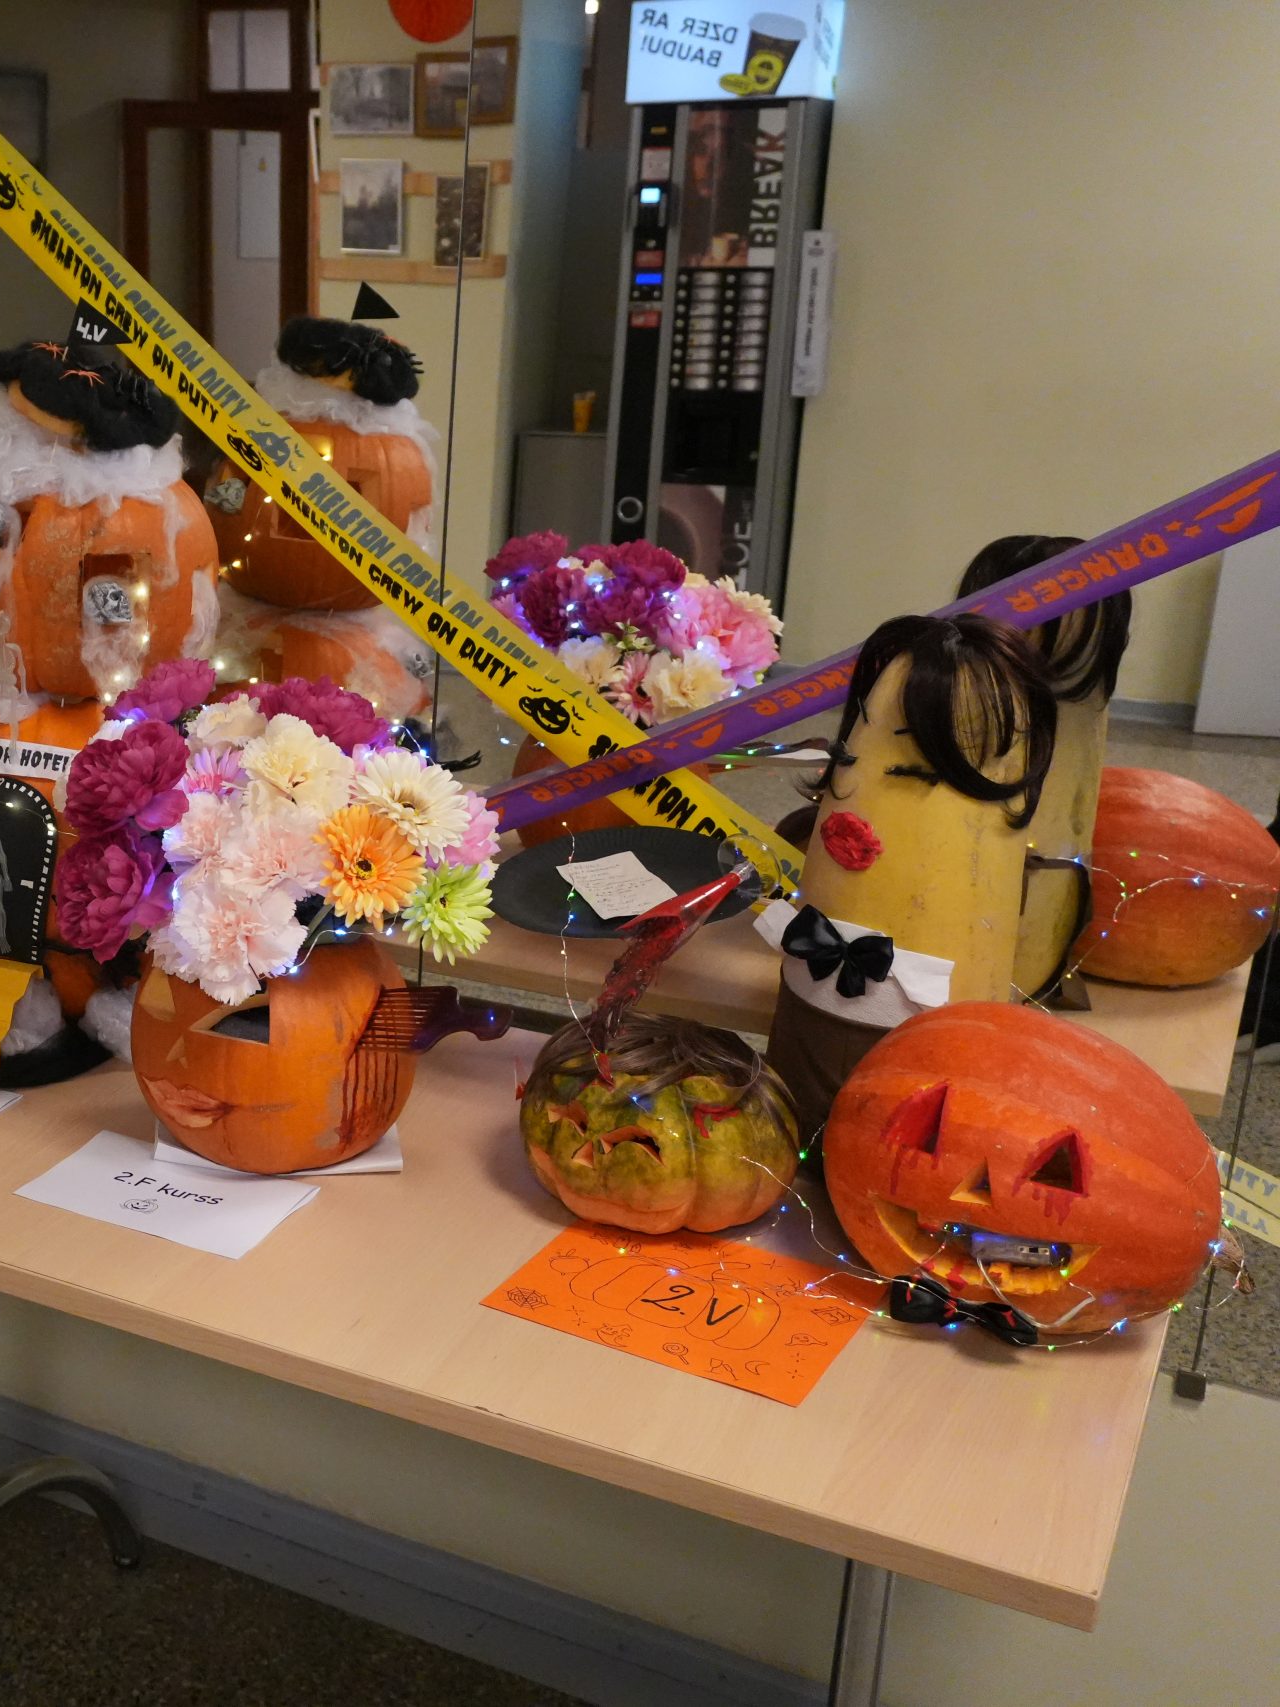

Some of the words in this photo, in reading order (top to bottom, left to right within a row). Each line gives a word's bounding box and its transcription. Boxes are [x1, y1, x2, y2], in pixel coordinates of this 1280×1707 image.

[30, 209, 103, 302] SKELETON
[104, 291, 149, 350] CREW
[151, 343, 174, 380] ON
[177, 371, 219, 424] DUTY
[76, 316, 108, 342] 4.V
[298, 472, 397, 560] SKELETON
[280, 480, 364, 568] SKELETON
[368, 563, 425, 617] CREW
[427, 611, 458, 647] ON
[458, 636, 519, 689] DUTY
[113, 1171, 157, 1187] 2.F
[156, 1183, 224, 1206] kurss
